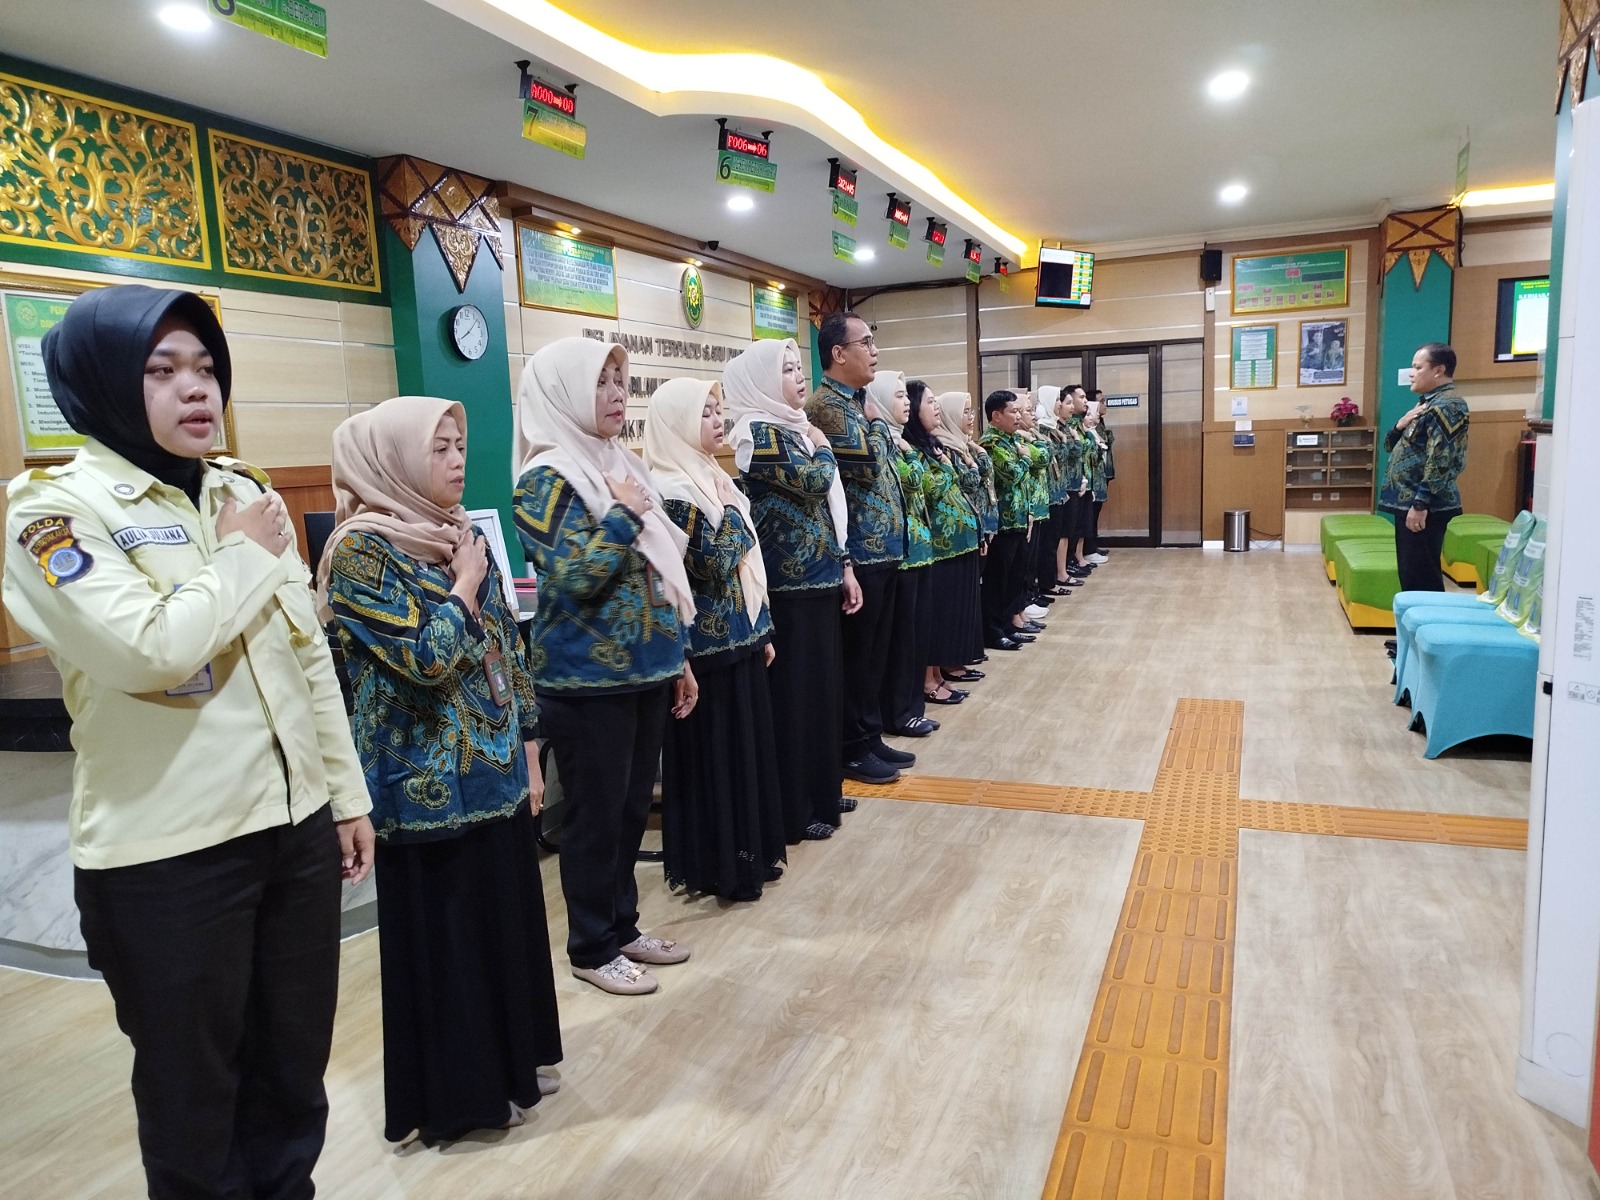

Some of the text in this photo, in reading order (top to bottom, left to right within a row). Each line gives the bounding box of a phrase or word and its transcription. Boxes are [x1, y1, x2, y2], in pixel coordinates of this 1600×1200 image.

[526, 104, 539, 136] 7
[720, 156, 731, 180] 6
[833, 194, 839, 214] 5
[22, 517, 65, 541] POLDA
[119, 529, 185, 548] AULIA JULIANA
